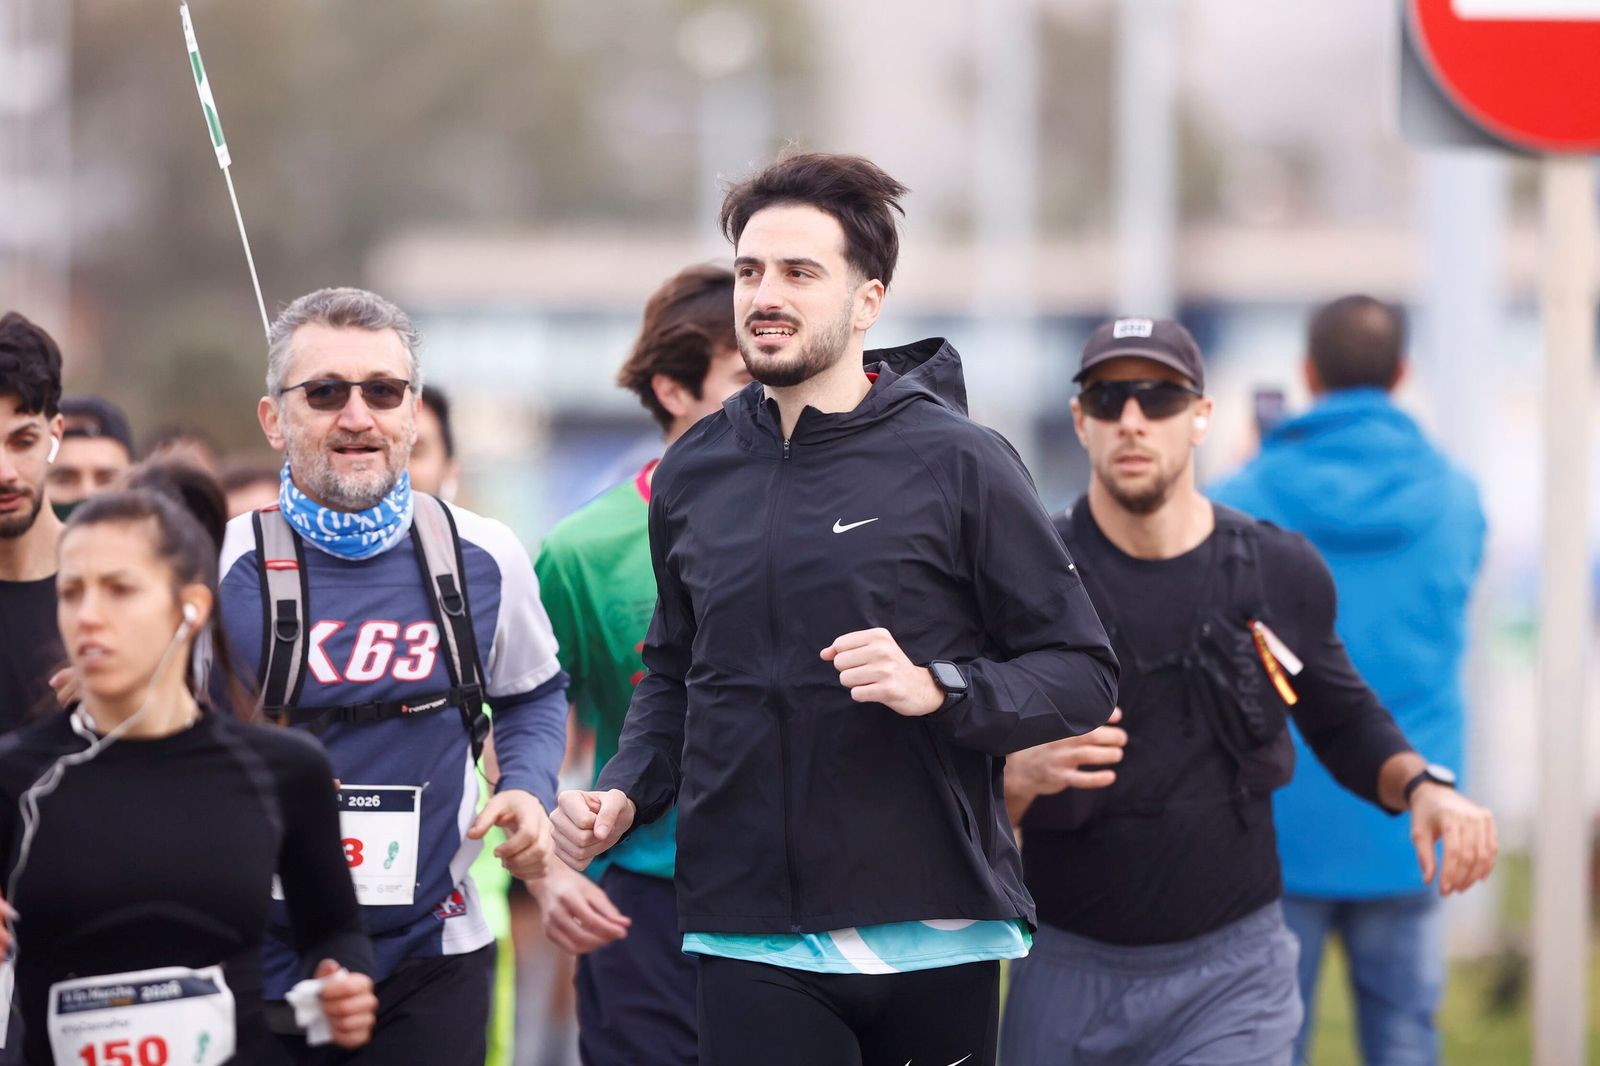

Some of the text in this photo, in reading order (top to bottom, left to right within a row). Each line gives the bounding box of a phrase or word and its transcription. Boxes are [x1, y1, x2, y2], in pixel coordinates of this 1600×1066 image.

[348, 795, 381, 807] 2026
[140, 979, 182, 1001] 2026
[79, 1035, 168, 1066] 150
